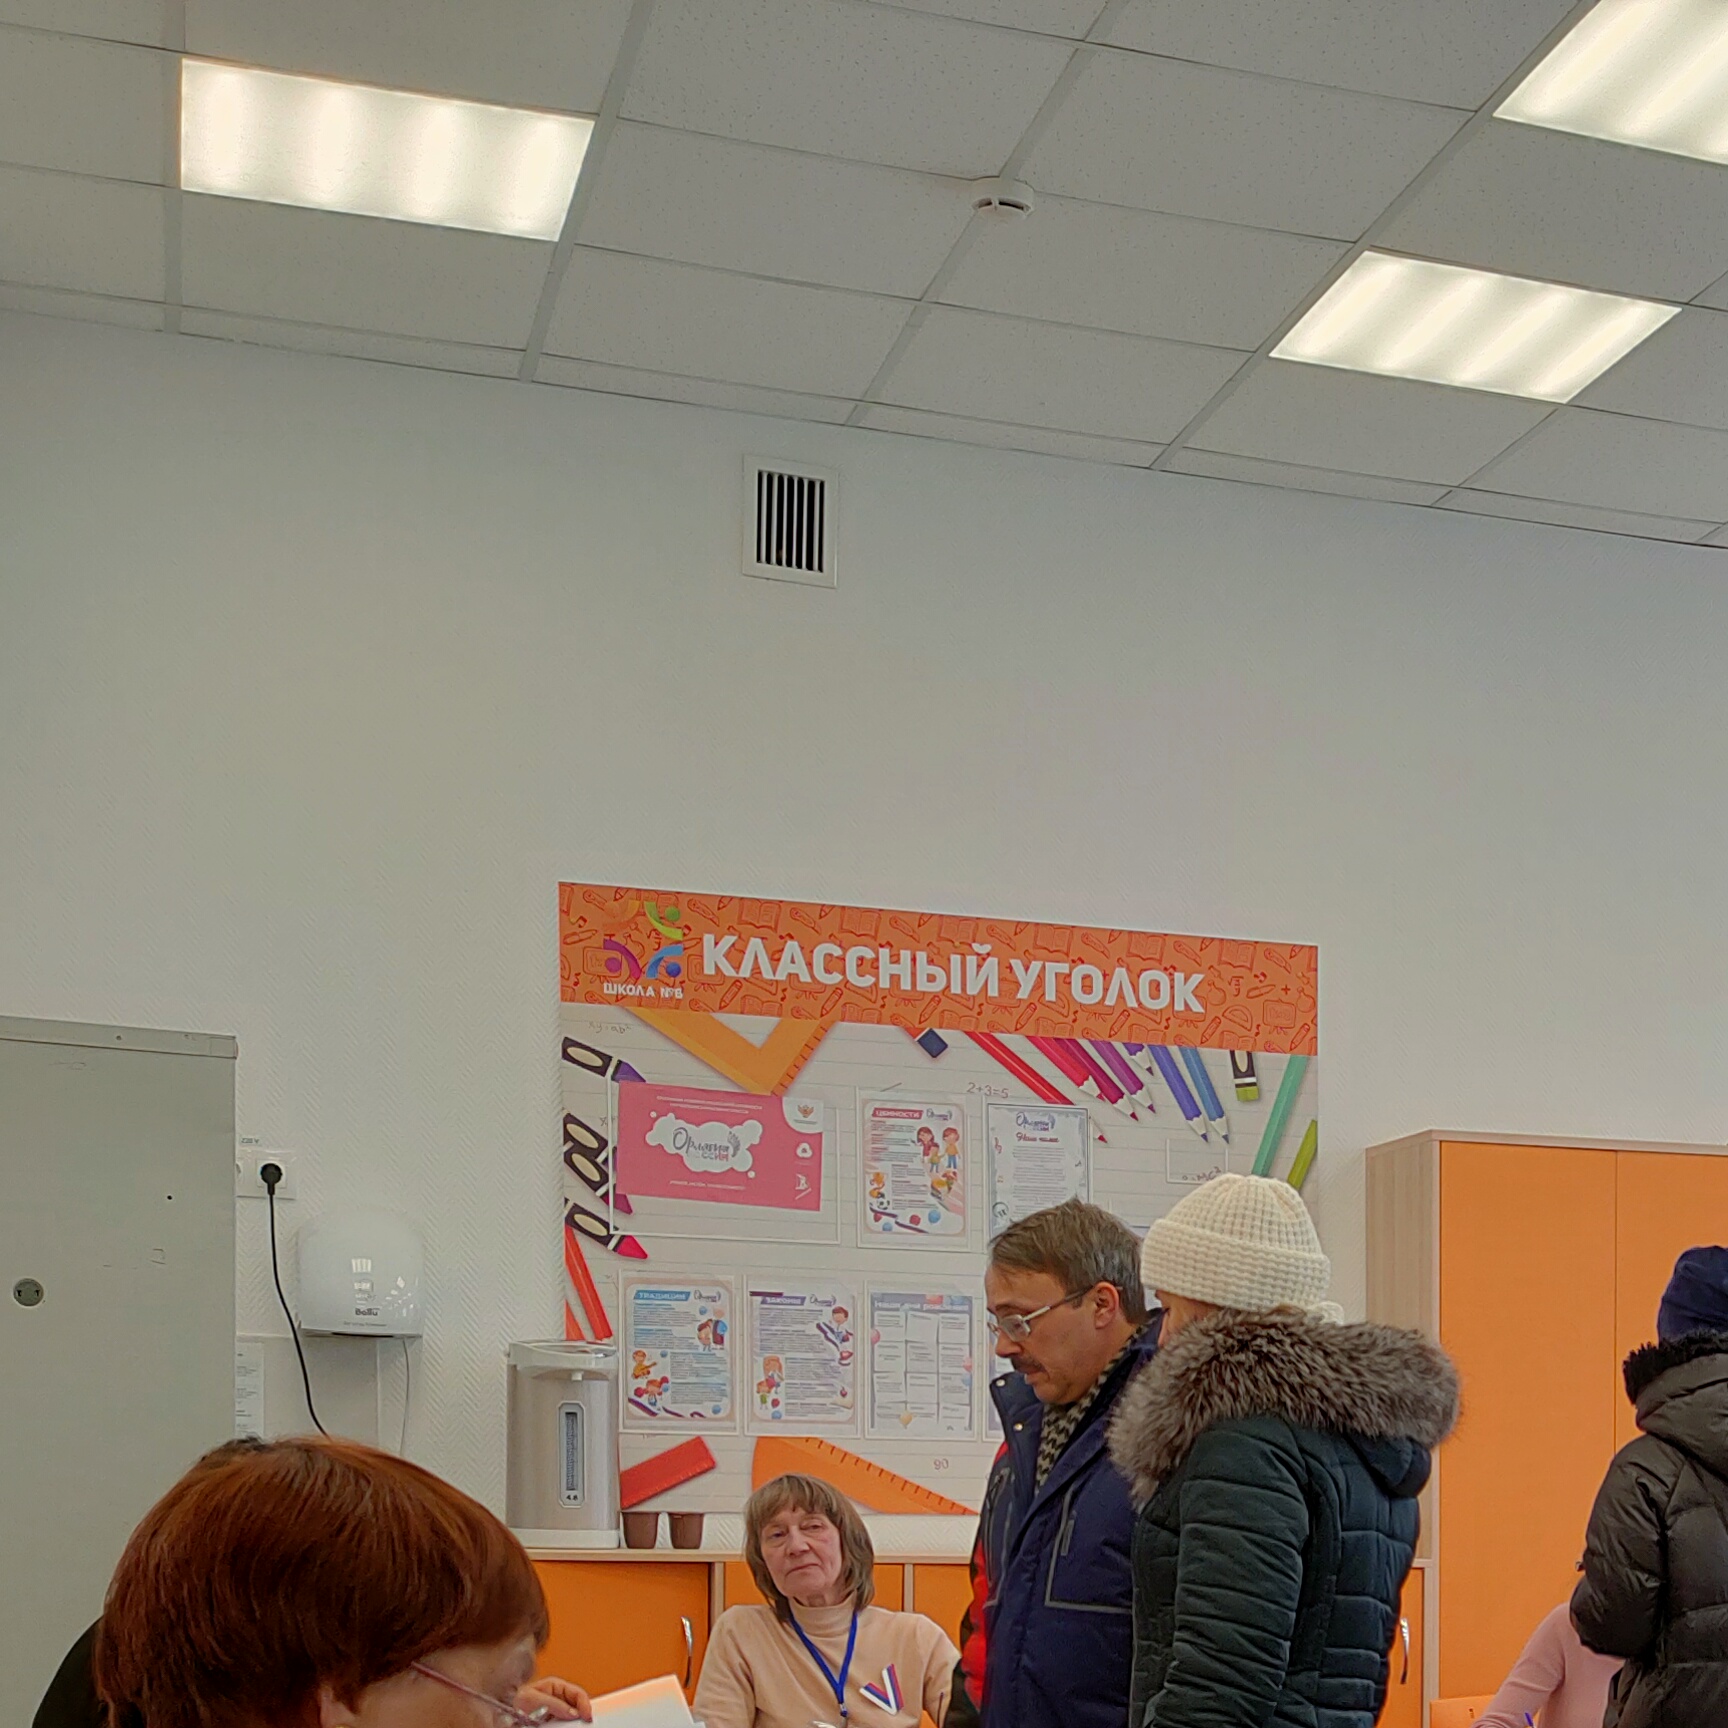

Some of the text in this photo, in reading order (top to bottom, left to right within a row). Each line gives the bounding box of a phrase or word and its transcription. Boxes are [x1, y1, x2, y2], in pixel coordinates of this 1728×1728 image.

[603, 982, 655, 997] ШКОЛА
[702, 932, 1205, 1014] КЛАССНЫЙ УГОЛОК
